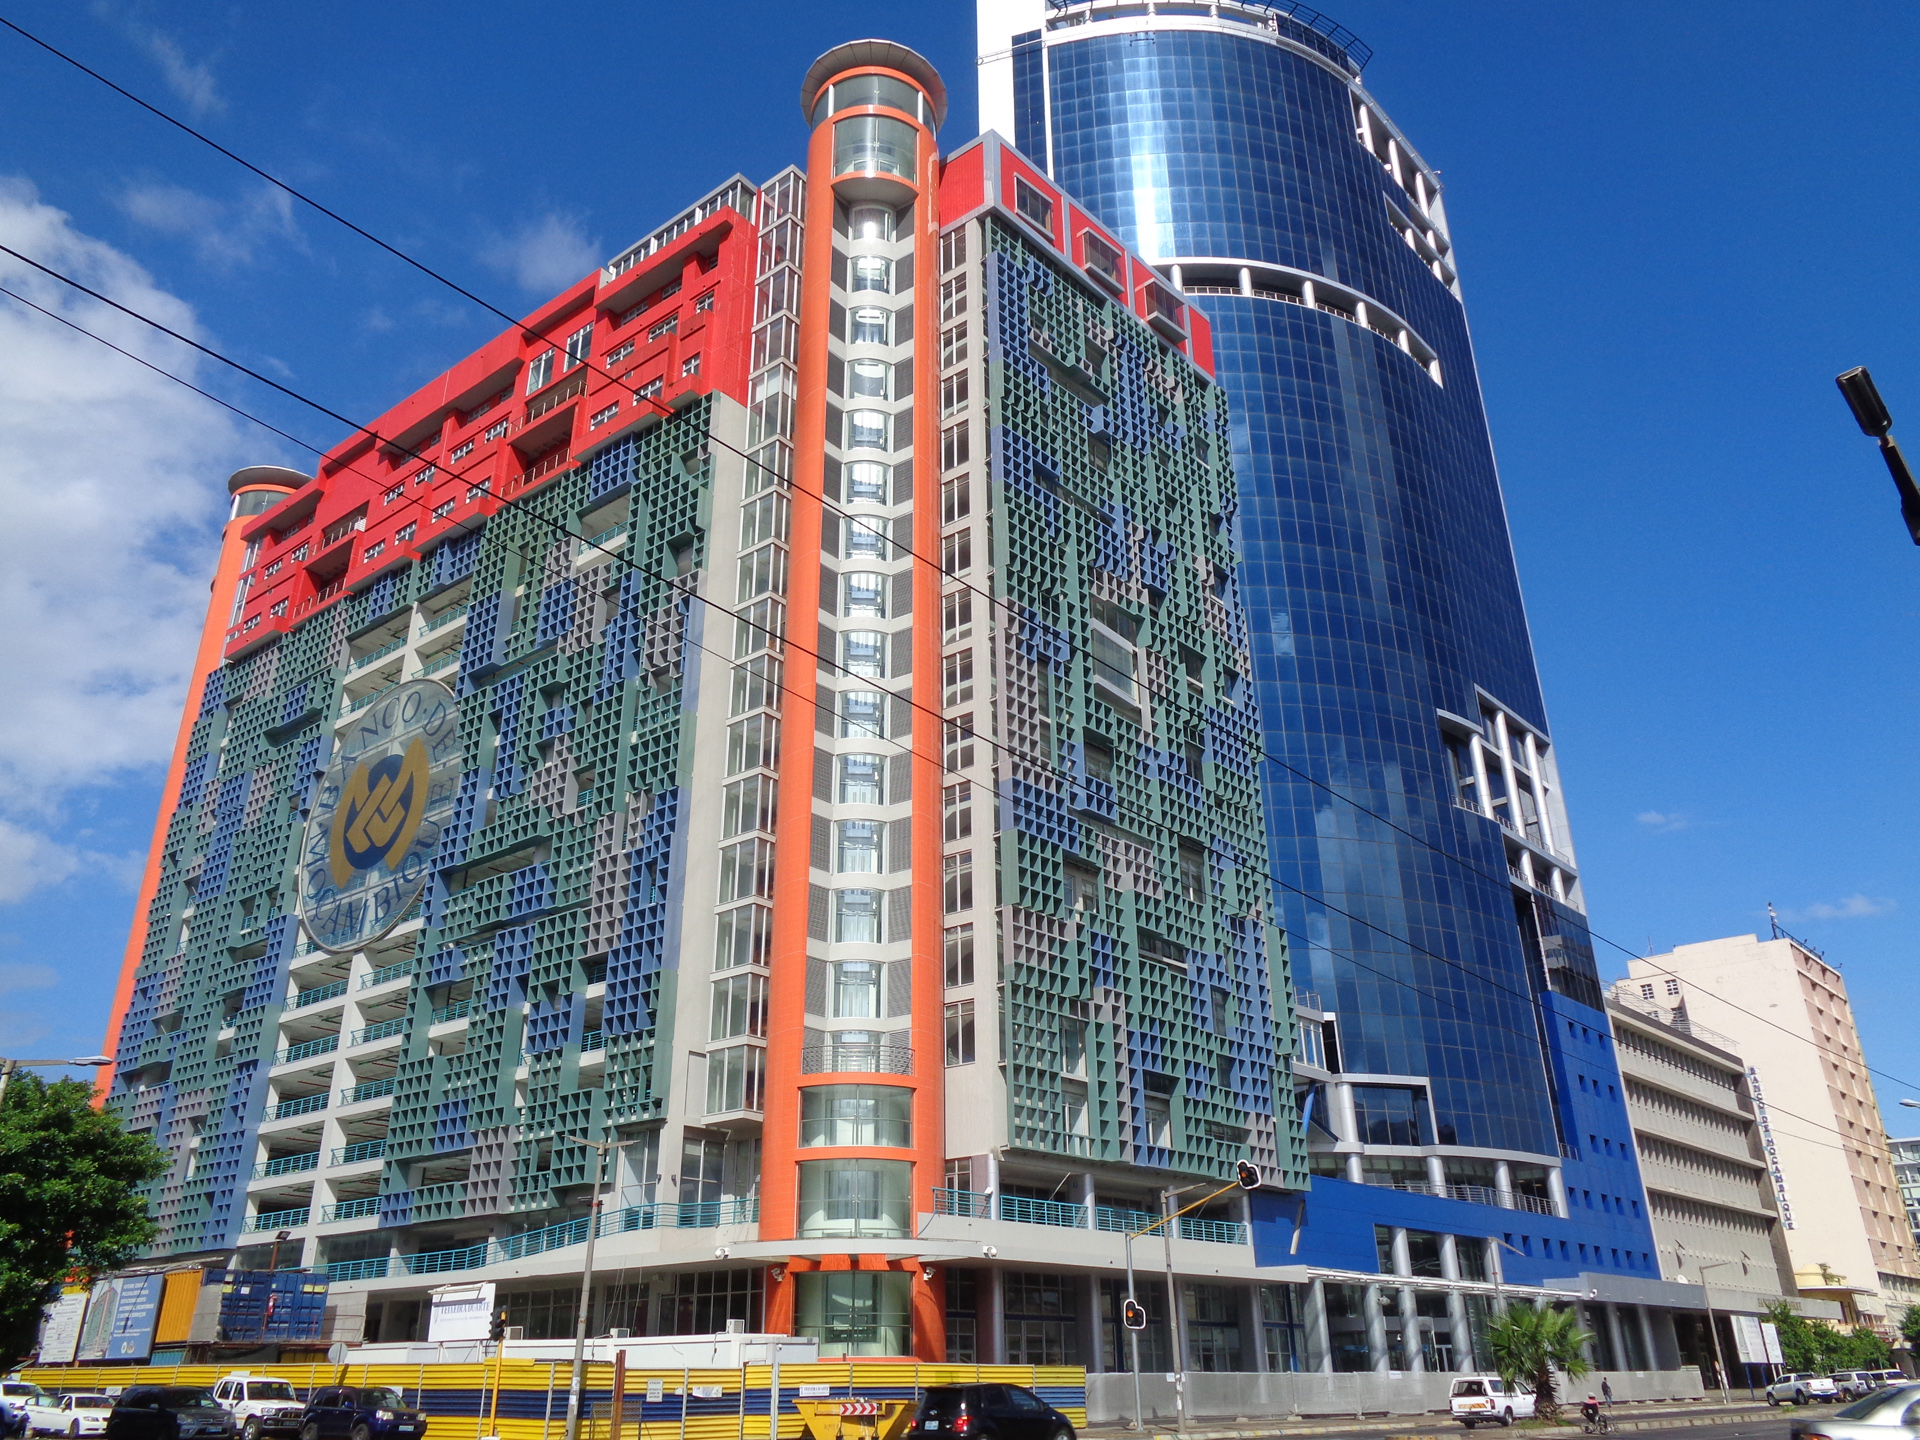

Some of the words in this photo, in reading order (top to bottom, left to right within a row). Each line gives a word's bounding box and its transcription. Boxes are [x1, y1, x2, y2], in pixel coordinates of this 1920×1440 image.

[318, 691, 422, 811] BANCO
[423, 700, 457, 763] DE
[1749, 1066, 1765, 1110] BANCO
[1761, 1115, 1770, 1133] DE
